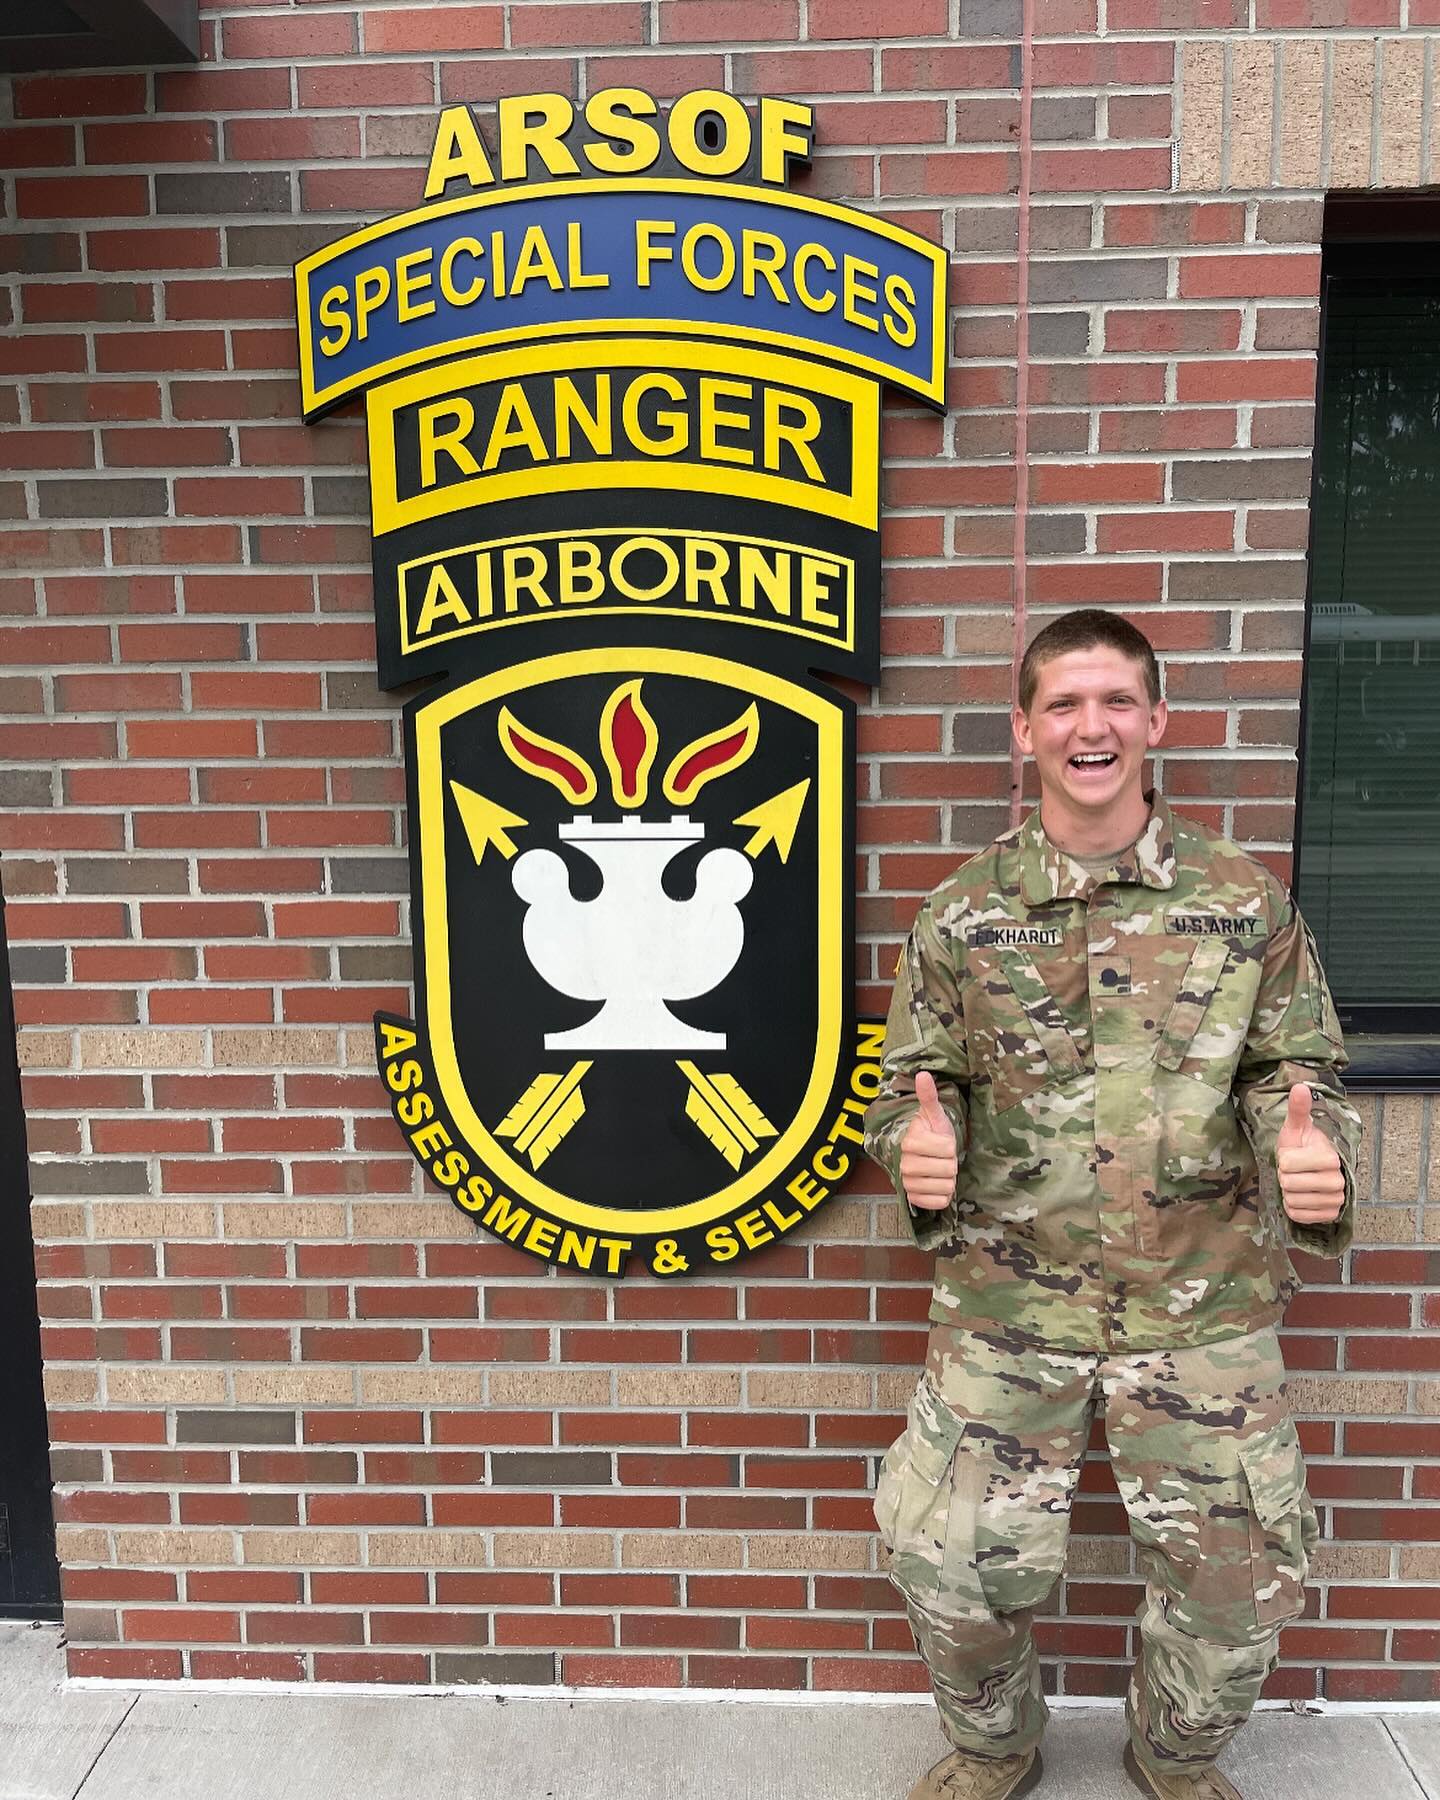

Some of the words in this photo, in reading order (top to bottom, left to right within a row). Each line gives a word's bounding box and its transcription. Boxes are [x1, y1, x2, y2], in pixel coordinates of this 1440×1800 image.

[425, 89, 812, 197] ARSOF
[319, 222, 609, 357] SPECIAL
[636, 220, 918, 347] FORCES
[418, 372, 826, 488] RANGER
[415, 538, 842, 634] AIRBORNE
[975, 928, 1057, 945] ECKHARDT
[379, 1022, 632, 1274] ASSESSMENT
[652, 1238, 689, 1274] &
[704, 1022, 889, 1262] SELECTION
